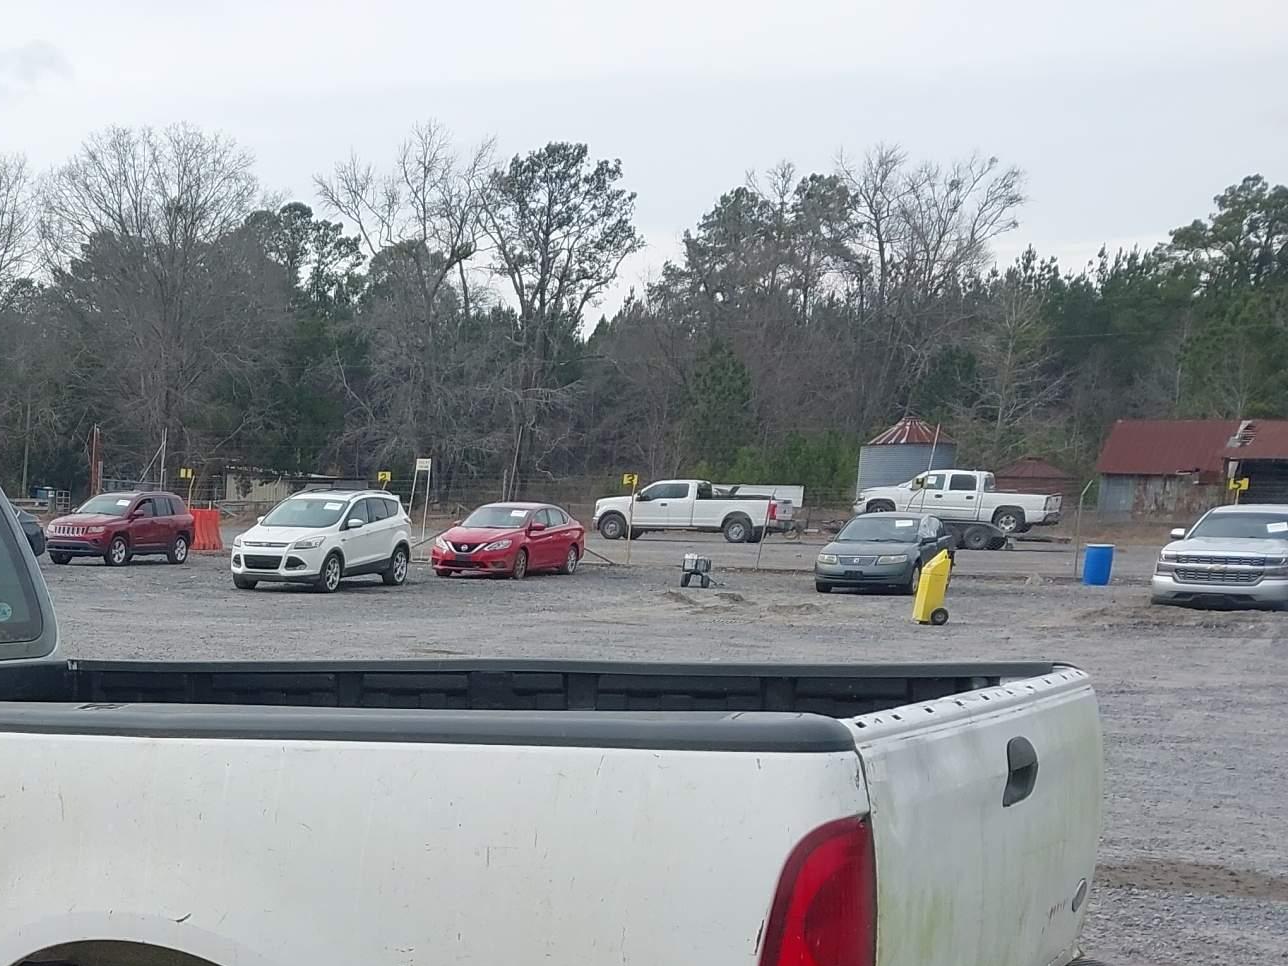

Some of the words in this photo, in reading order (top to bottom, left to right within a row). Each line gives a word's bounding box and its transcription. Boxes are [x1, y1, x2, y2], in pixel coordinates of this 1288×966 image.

[626, 474, 635, 485] 3
[916, 478, 925, 489] 4
[1233, 478, 1242, 489] 5
